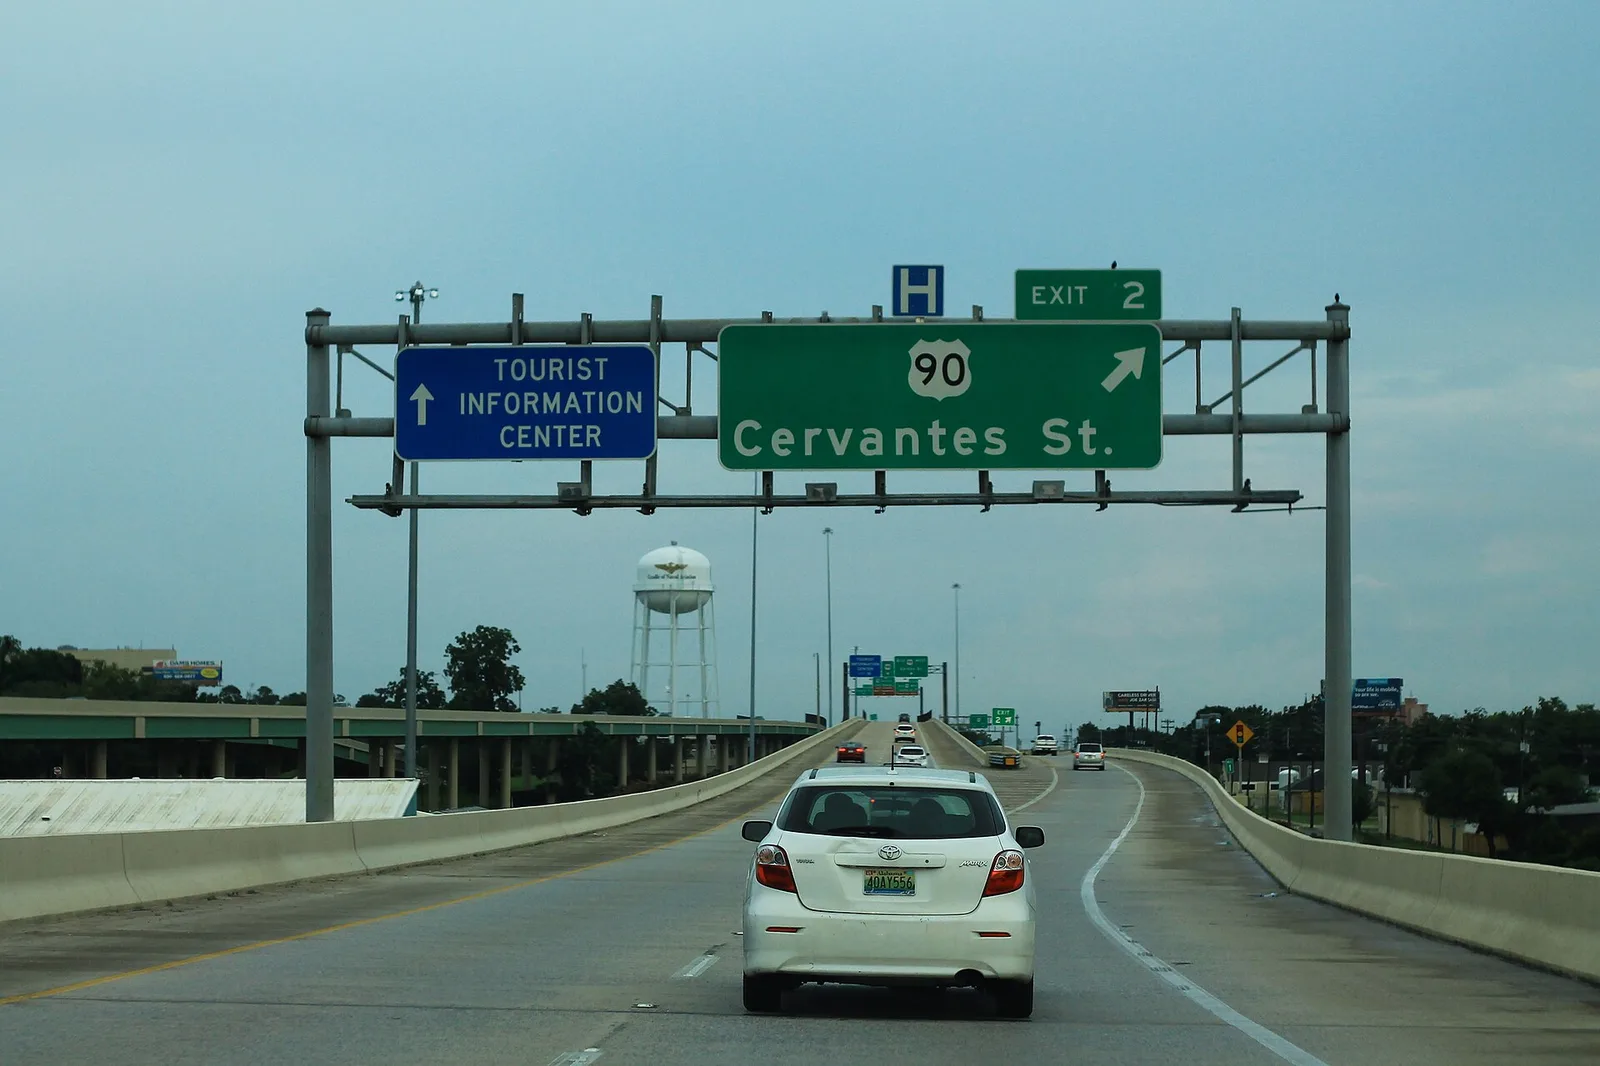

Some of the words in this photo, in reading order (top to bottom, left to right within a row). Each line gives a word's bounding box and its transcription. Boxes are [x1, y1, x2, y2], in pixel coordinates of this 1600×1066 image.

[900, 267, 937, 314] H
[1031, 285, 1089, 305] EXIT
[1122, 281, 1146, 309] 2
[494, 357, 609, 381] TOURIST
[914, 352, 967, 387] 90
[460, 391, 643, 415] INFORMATION
[500, 424, 602, 448] CENTER
[733, 418, 1008, 457] Cervantes
[1042, 418, 1114, 456] St.
[867, 876, 913, 889] 40AY556
